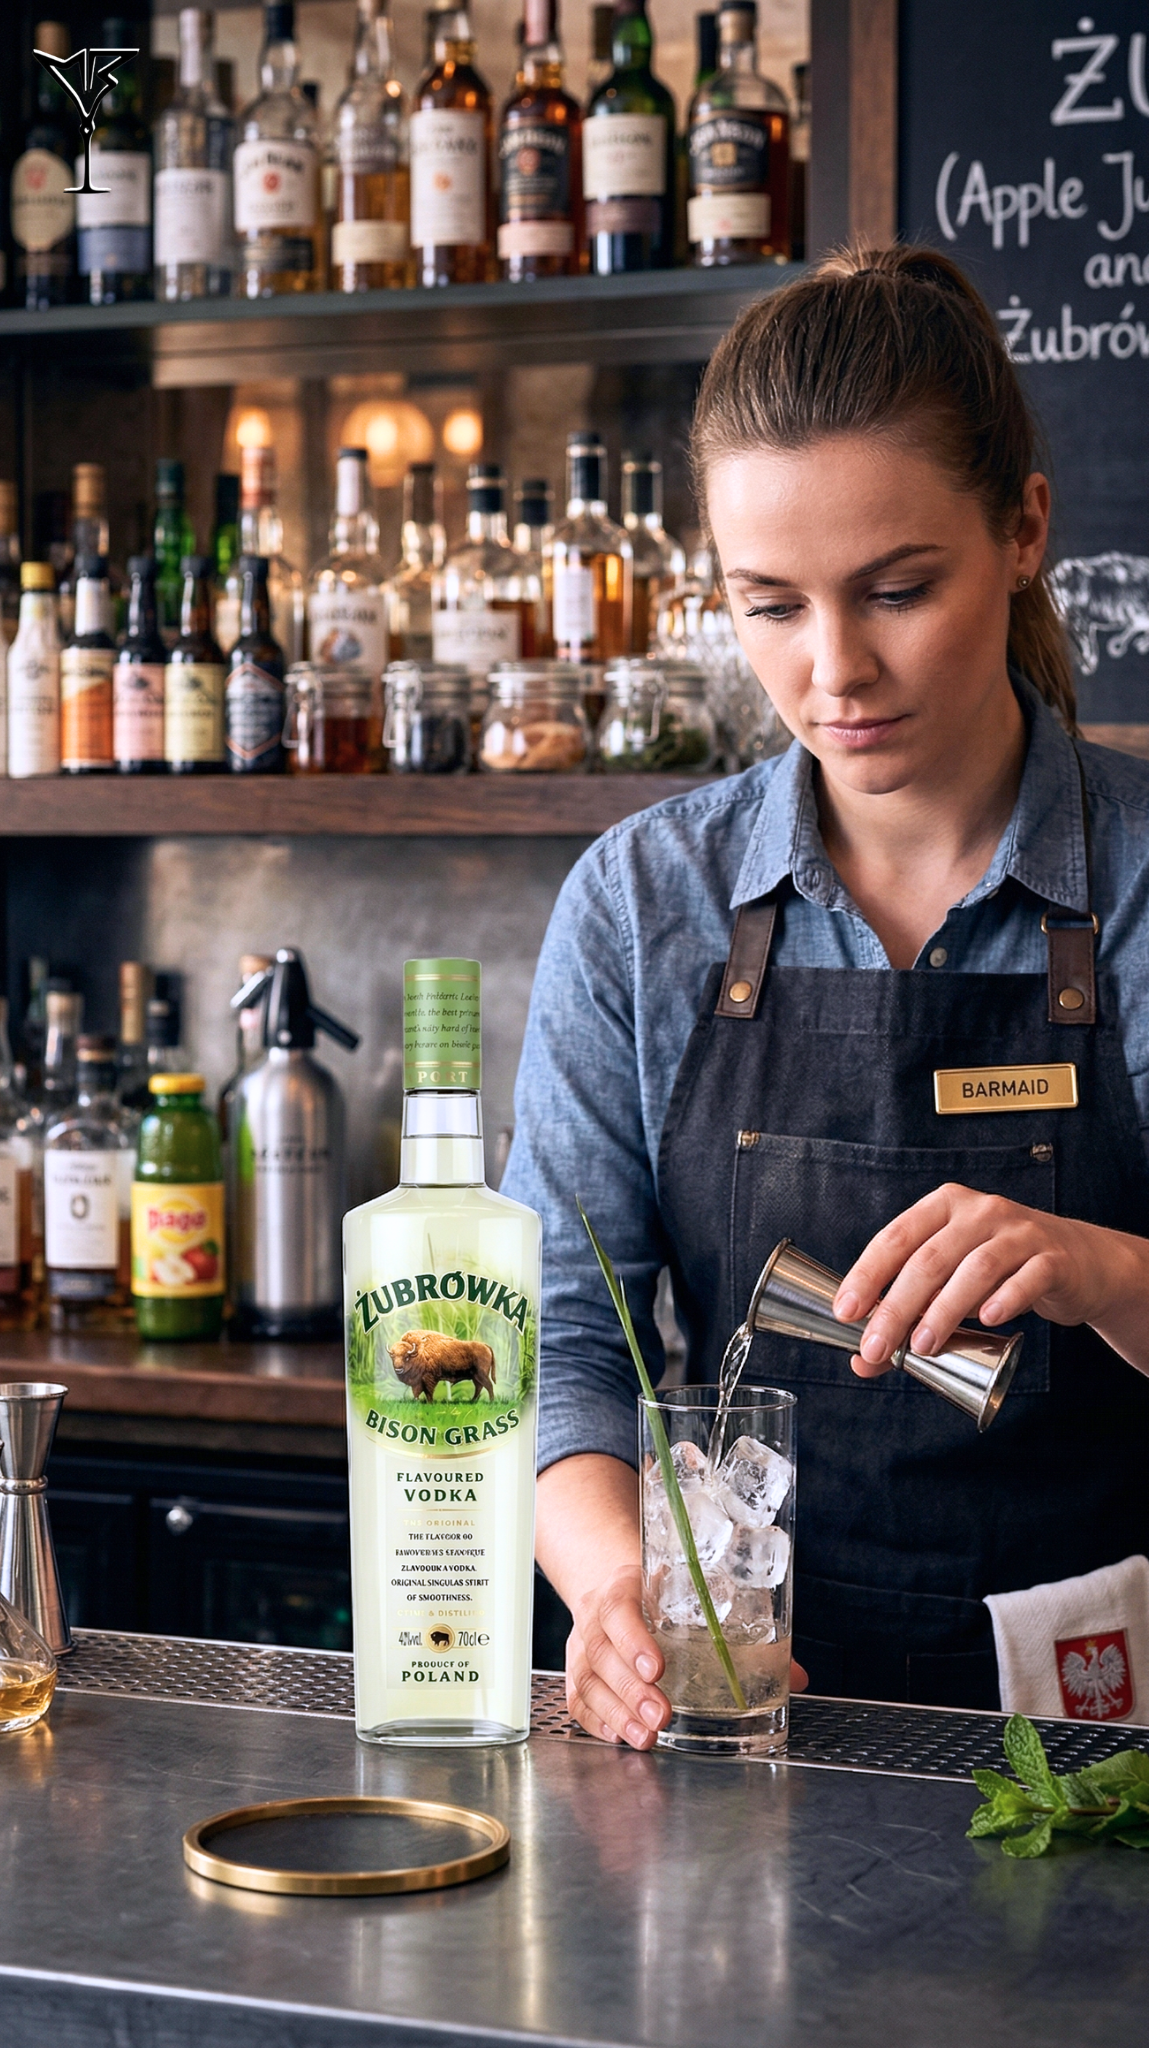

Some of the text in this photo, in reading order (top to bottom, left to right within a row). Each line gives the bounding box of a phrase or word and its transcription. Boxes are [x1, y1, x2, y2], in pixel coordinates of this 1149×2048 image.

[935, 151, 1088, 249] (Apple
[428, 1008, 440, 1017] the
[442, 1008, 458, 1017] best
[441, 1024, 460, 1033] hard
[962, 1079, 1049, 1099] BARMAID
[354, 1271, 529, 1334] ŻUBRÓWKA
[365, 1409, 520, 1446] BISON GRASS
[397, 1472, 484, 1482] FLAVOURED
[404, 1489, 477, 1502] VODKA
[408, 1533, 424, 1541] THE
[390, 1579, 426, 1587] ORIGINAL
[406, 1594, 473, 1602] OF SMOOTHNESS.
[402, 1671, 479, 1682] POLAND
